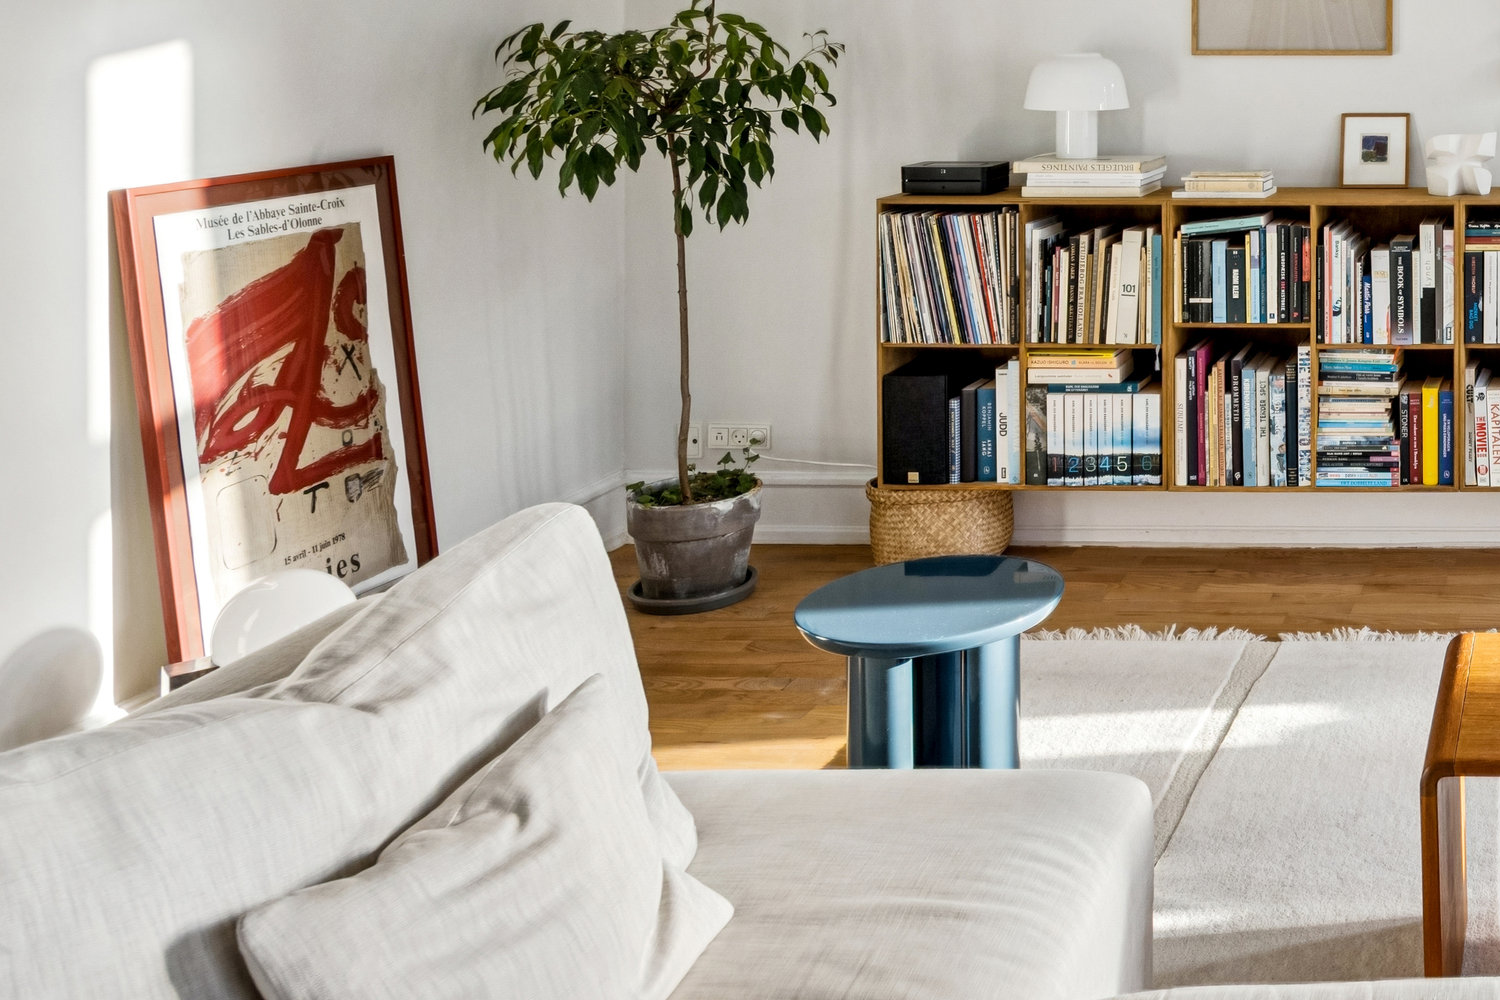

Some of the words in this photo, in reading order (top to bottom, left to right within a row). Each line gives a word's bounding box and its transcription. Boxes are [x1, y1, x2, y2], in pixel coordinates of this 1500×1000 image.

[1041, 163, 1088, 171] PAINTINGS
[1090, 163, 1134, 171] BRUEGEL'S
[196, 214, 229, 230] Musée
[232, 213, 244, 225] de
[246, 207, 286, 222] l'Abbaye
[288, 197, 345, 216] Sainte-Croix
[227, 228, 245, 240] Les
[247, 216, 323, 236] Sables-d'Olonne
[1122, 284, 1136, 293] 101
[1243, 378, 1251, 430] KØBENHAVNERNE
[999, 413, 1008, 437] JUDD
[1176, 403, 1184, 434] SUBLIME
[1477, 422, 1487, 453] MOVIE
[1068, 457, 1079, 473] 2
[1085, 456, 1096, 472] 3
[1099, 456, 1110, 472] 4
[1116, 456, 1128, 472] 5
[1141, 455, 1152, 471] 6
[284, 555, 292, 566] 15
[292, 549, 307, 562] avril
[311, 544, 319, 554] 11
[319, 539, 331, 553] juin
[331, 532, 346, 545] 1978
[326, 552, 361, 579] ies
